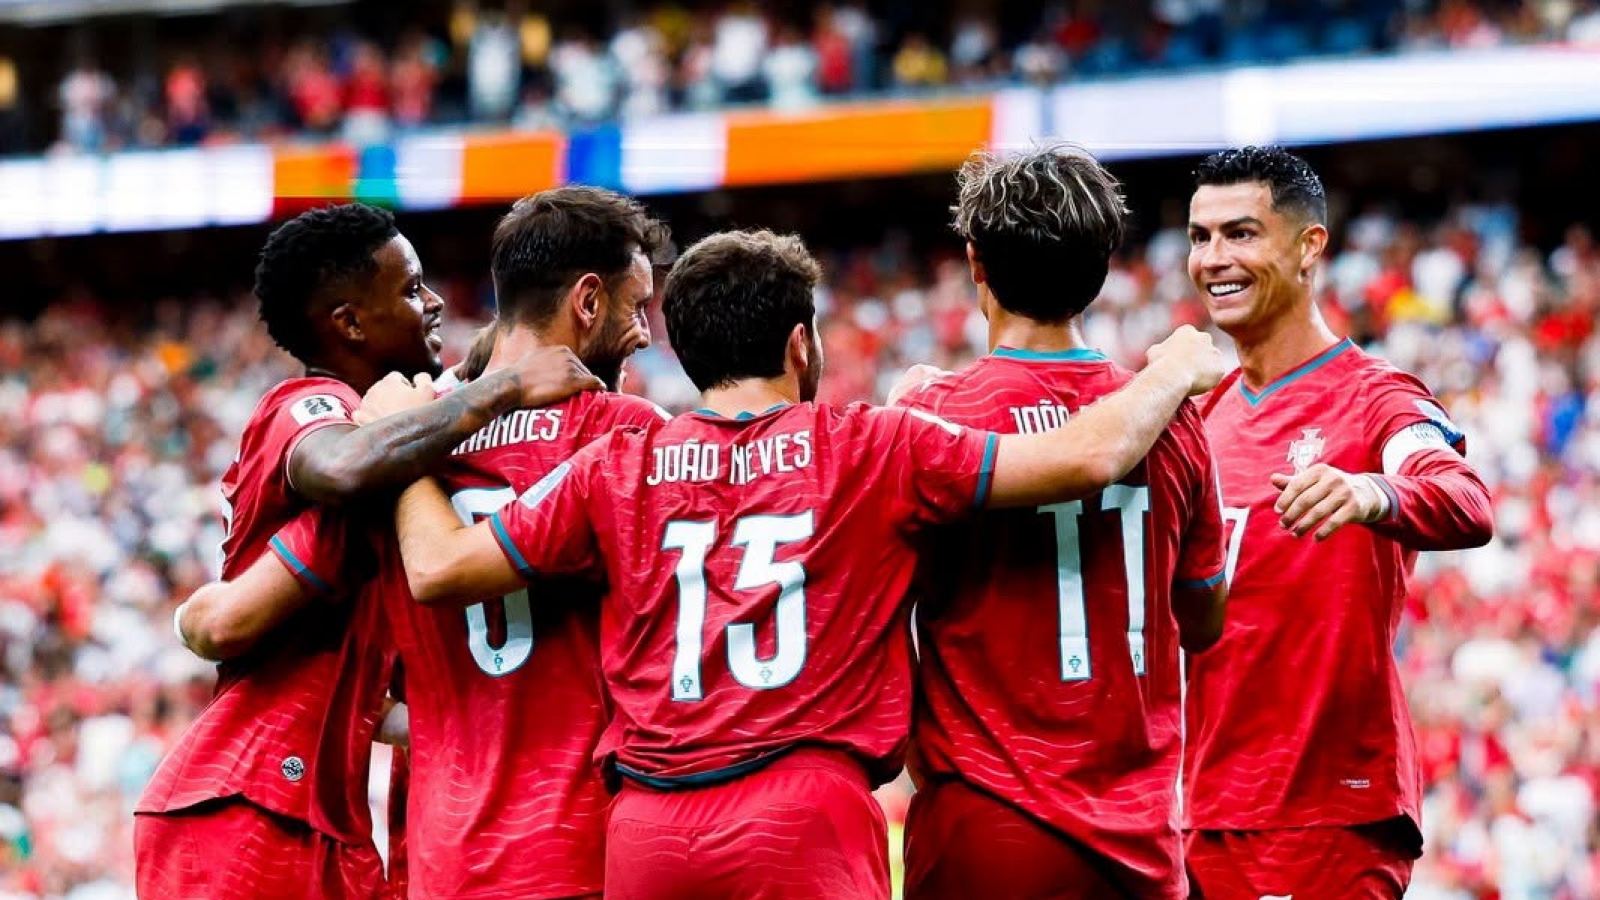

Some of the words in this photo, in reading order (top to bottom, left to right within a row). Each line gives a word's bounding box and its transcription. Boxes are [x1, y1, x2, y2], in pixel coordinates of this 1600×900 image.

[647, 439, 719, 486] JOÃO
[729, 430, 812, 485] NEVES
[661, 508, 815, 702] 15
[1036, 484, 1149, 681] 11
